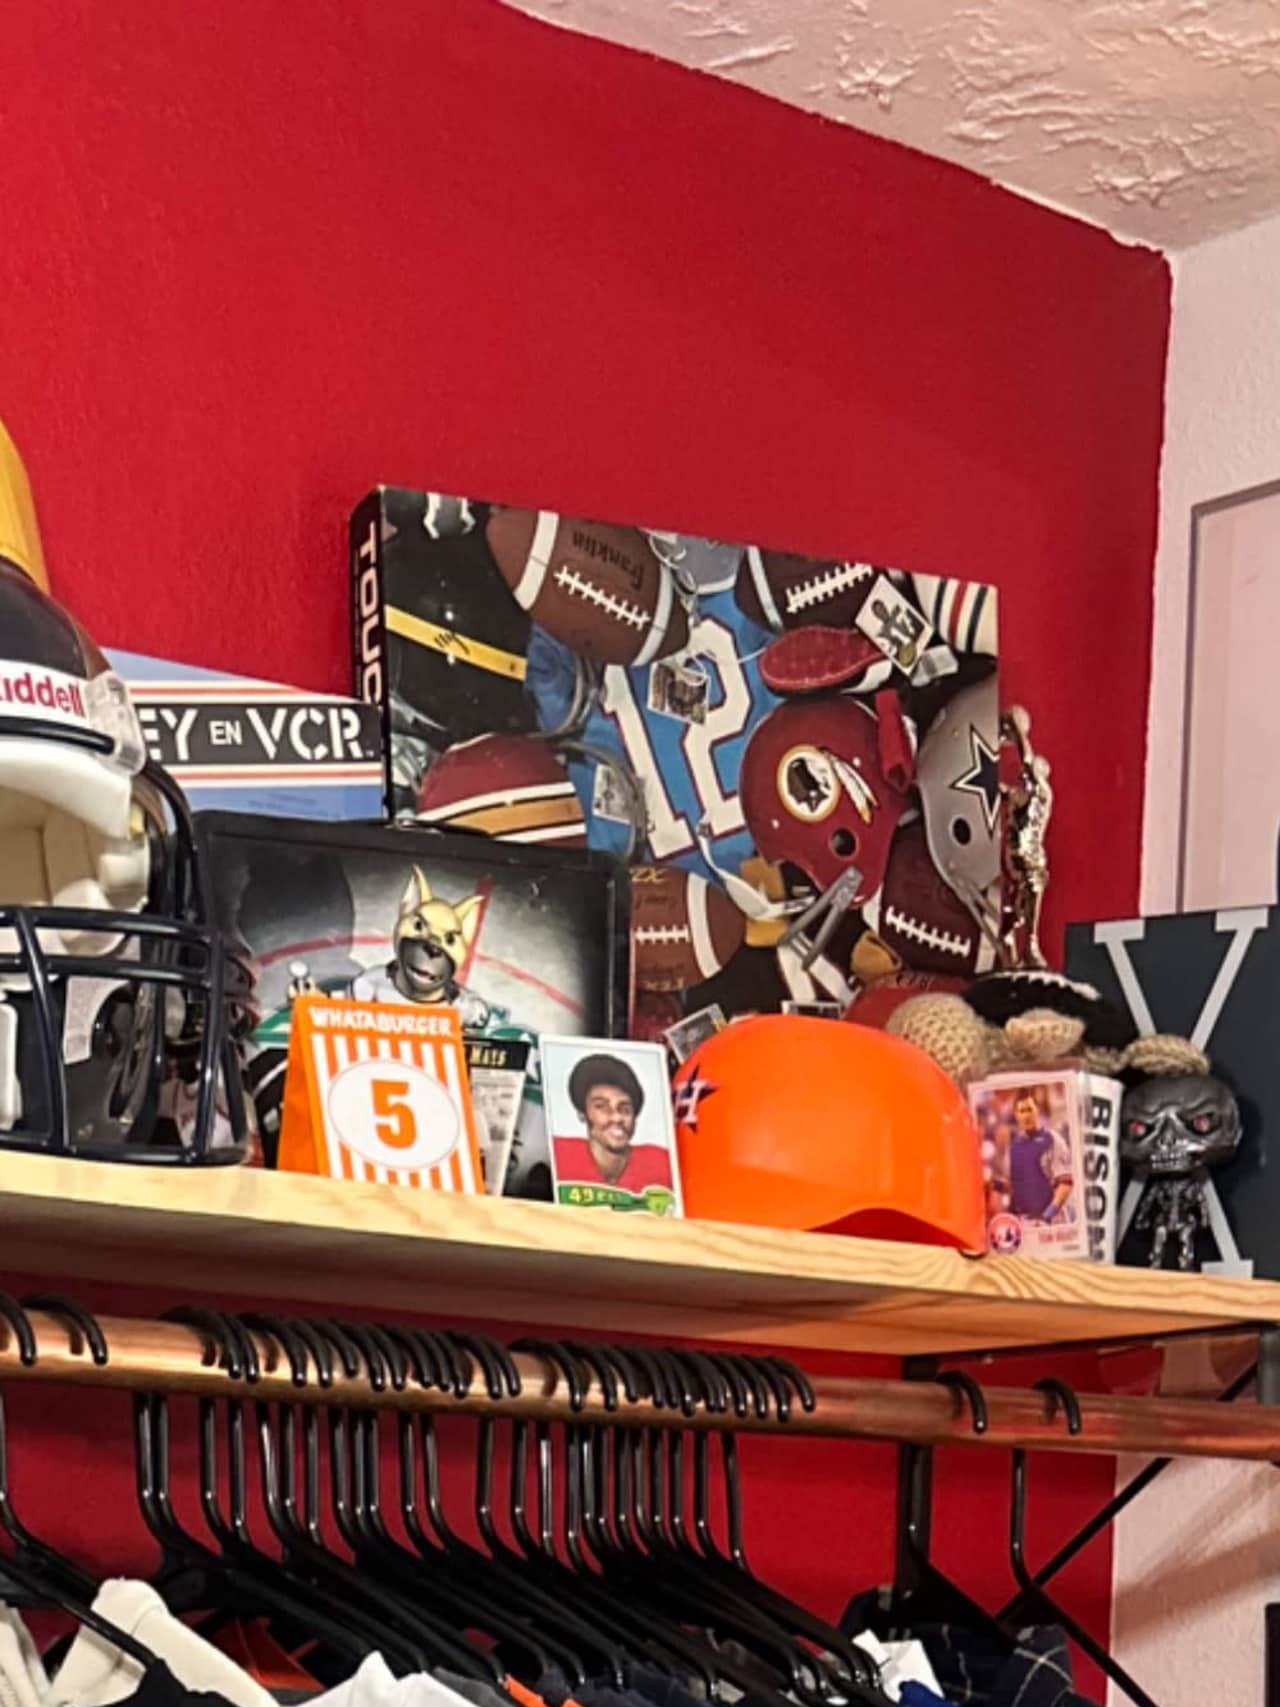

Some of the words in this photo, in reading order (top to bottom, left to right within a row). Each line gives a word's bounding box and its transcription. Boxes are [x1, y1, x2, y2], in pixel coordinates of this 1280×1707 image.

[211, 719, 243, 746] EN
[246, 707, 364, 761] VCR
[308, 1006, 453, 1037] WHATABURGER
[369, 1078, 417, 1151] 5
